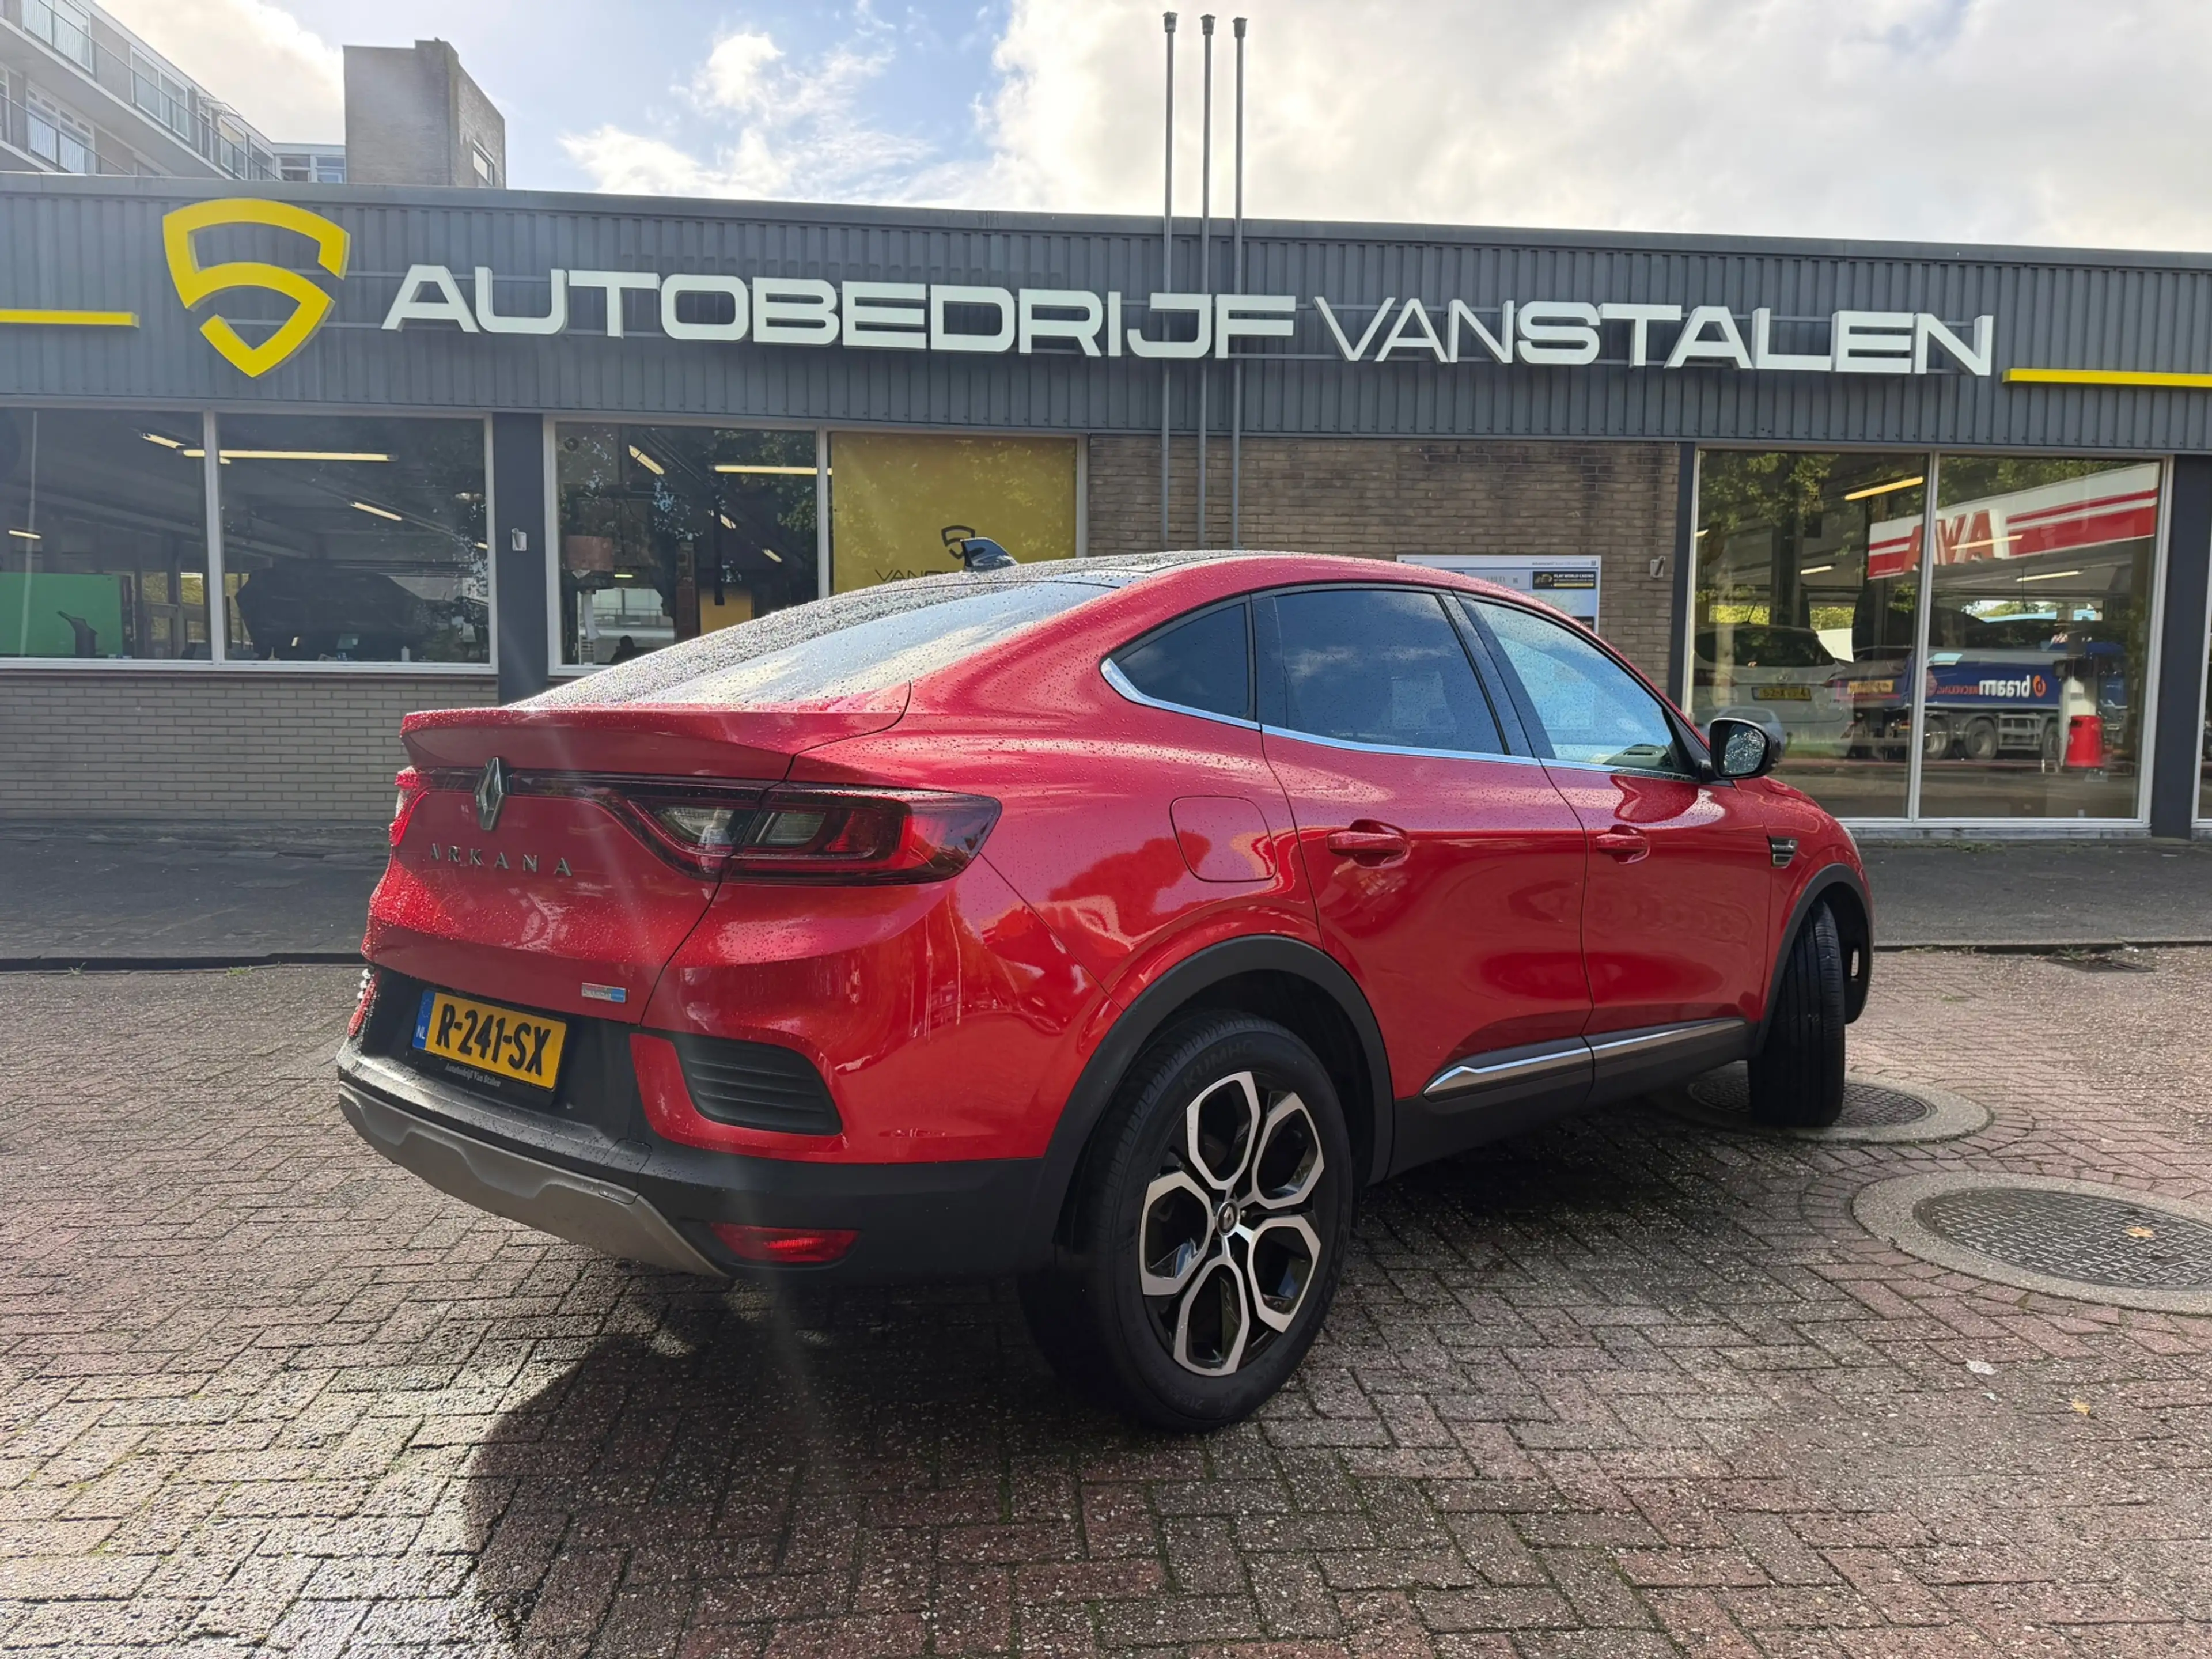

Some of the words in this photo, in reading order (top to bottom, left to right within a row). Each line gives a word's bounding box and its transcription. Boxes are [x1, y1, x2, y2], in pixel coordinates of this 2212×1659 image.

[381, 264, 1296, 361] AUTOBEDRIJF
[430, 842, 573, 877] ARKANA
[416, 1025, 426, 1040] NL
[435, 1003, 551, 1077] R-241-SX
[1183, 1037, 1255, 1091] KUMHO
